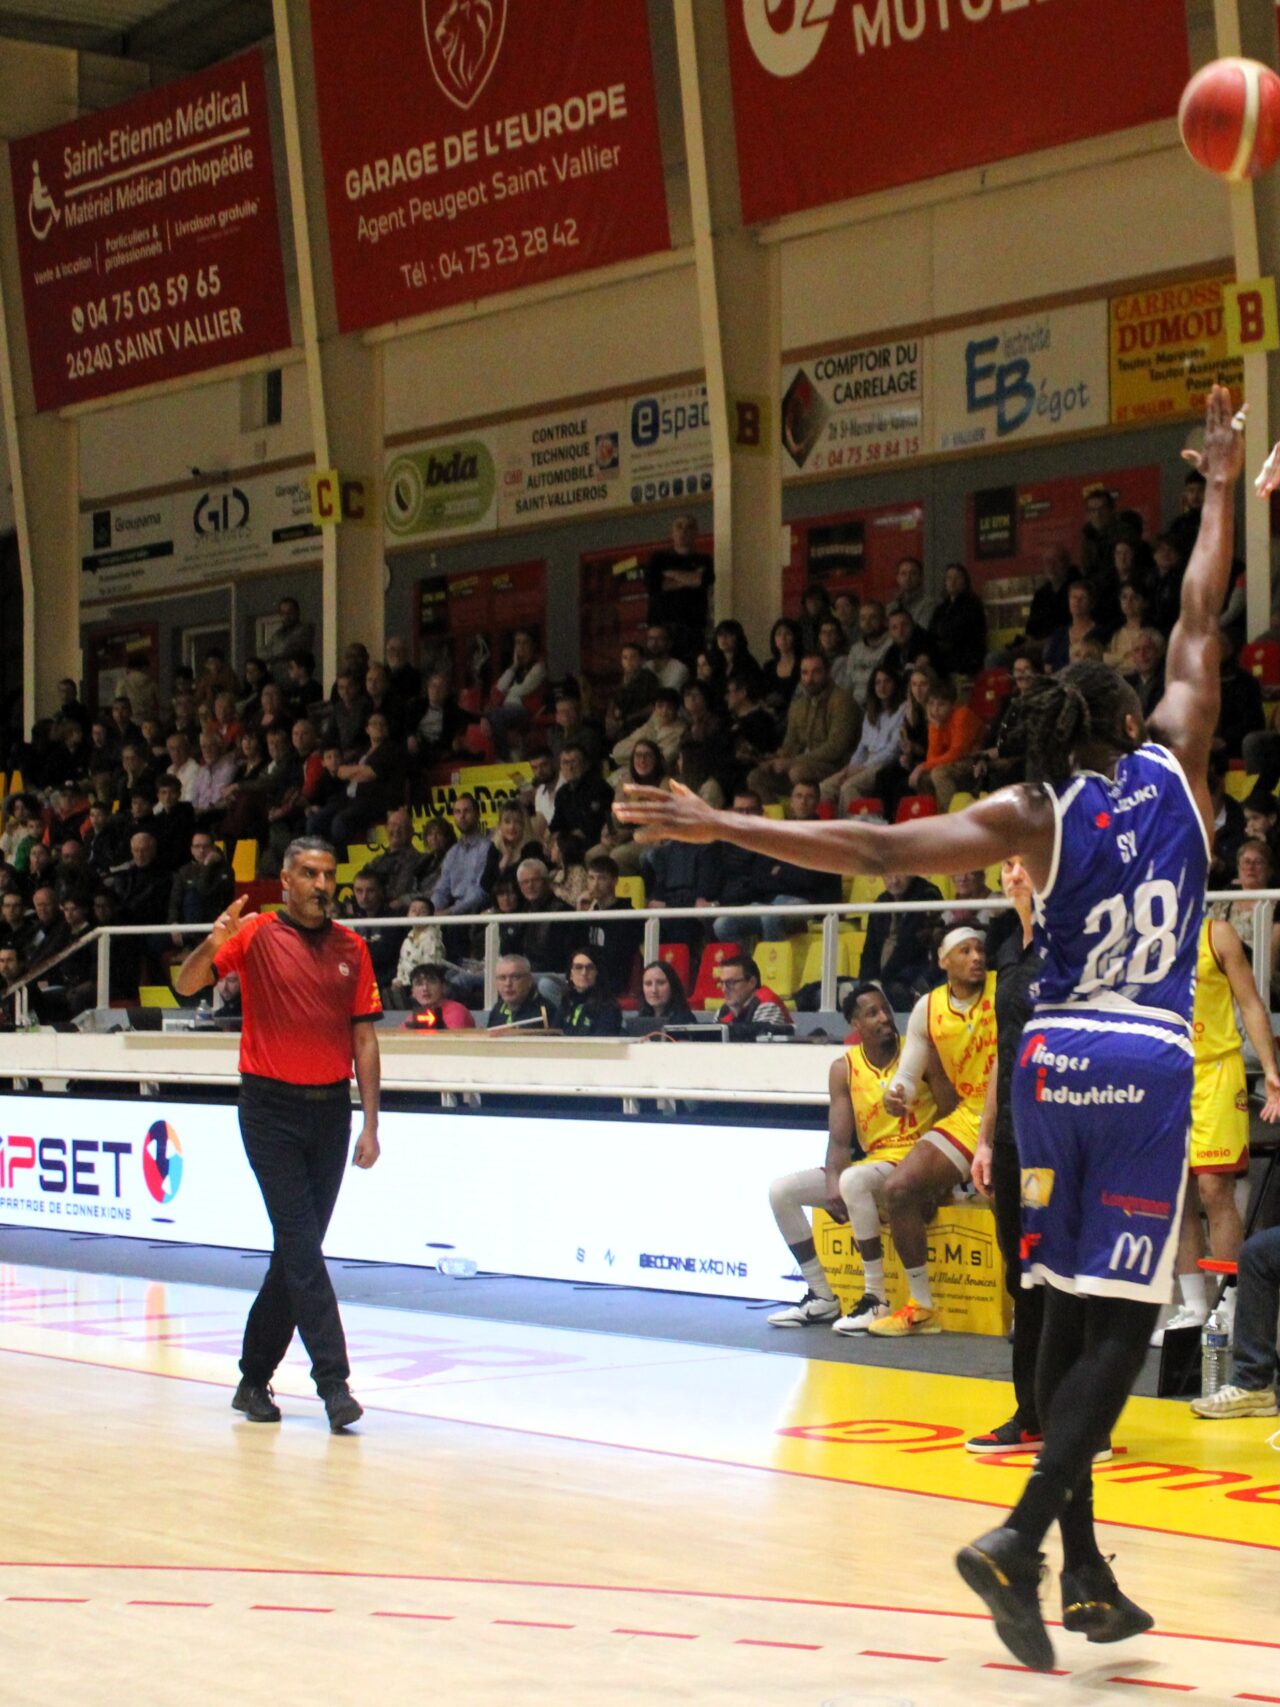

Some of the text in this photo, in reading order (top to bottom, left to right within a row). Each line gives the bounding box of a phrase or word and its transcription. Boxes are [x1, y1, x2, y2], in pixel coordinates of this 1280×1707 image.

[63, 80, 250, 181] Saint-Etienne Médical
[345, 83, 628, 201] GARAGE DE L'EUROPE
[64, 144, 254, 229] Matériel Médical Orthopédie
[357, 145, 621, 244] Agent Peugeot Saint Vallier
[400, 261, 427, 289] Tél
[439, 252, 464, 280] 04
[465, 243, 490, 273] 75
[492, 234, 519, 266] 23
[521, 226, 548, 258] 28
[552, 217, 580, 248] 42
[87, 264, 221, 330] 04 75 03 59 65
[1115, 284, 1222, 320] CARROSS
[1119, 307, 1224, 352] DUMOU
[1238, 291, 1265, 344] B
[66, 306, 244, 380] 26240 SAINT VALLIER
[814, 342, 918, 382] COMPTOIR DU
[833, 370, 918, 404] CARRELAGE
[532, 419, 588, 444] CONTROLE
[737, 402, 762, 446] B
[427, 450, 479, 487] bda
[531, 442, 590, 467] TECHNIQUE
[527, 464, 595, 490] AUTOMOBILE
[317, 479, 333, 518] C
[343, 481, 365, 519] C
[515, 484, 608, 514] SAINT-VALLIEROIS
[1116, 830, 1138, 864] SY
[1073, 879, 1179, 992] 28
[1035, 1067, 1146, 1106] industriels
[66, 1203, 132, 1220] CONNEXIONS
